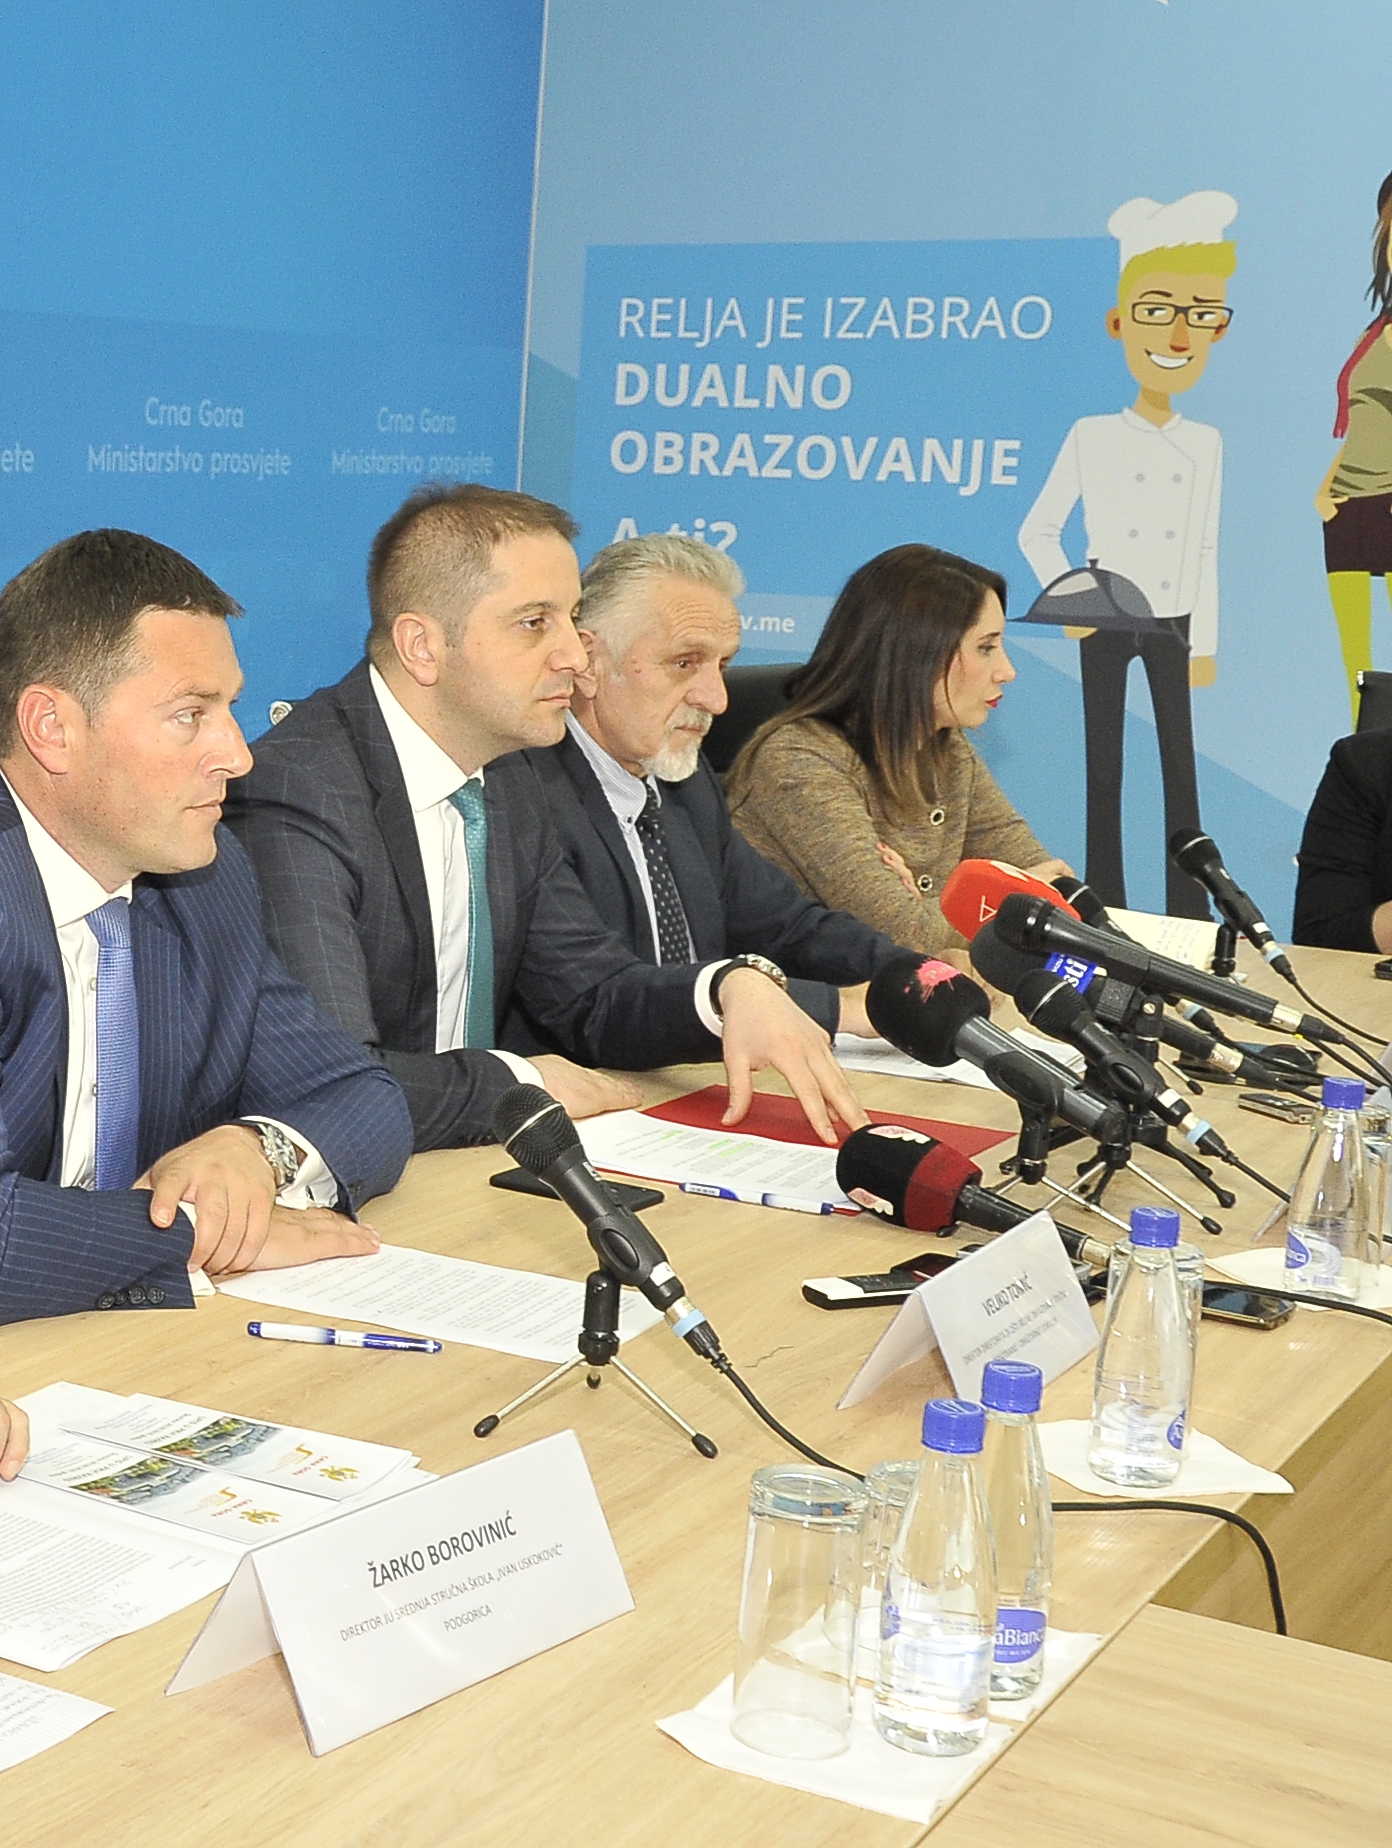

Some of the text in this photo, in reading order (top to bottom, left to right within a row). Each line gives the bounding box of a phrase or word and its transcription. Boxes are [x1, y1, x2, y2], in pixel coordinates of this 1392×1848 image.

[617, 295, 1053, 349] RELJA JE IZABRAO
[614, 363, 853, 411] DUALNO
[145, 396, 244, 429] Crna Gora
[378, 406, 457, 434] Crna Gora
[88, 443, 291, 481] Ministarstvo prosvjete
[332, 448, 493, 480] Ministarstvo prosvjete
[609, 430, 1022, 497] OBRAZOVANJE
[367, 1510, 517, 1588] ŽARKO BOROVINIĆ
[340, 1615, 384, 1642] DIREKTOR
[383, 1611, 396, 1627] JU
[395, 1597, 432, 1620] SREDNJA
[430, 1582, 470, 1606] STRUČNA
[468, 1572, 496, 1591] ŠKOLA
[443, 1603, 493, 1632] PODGORICA
